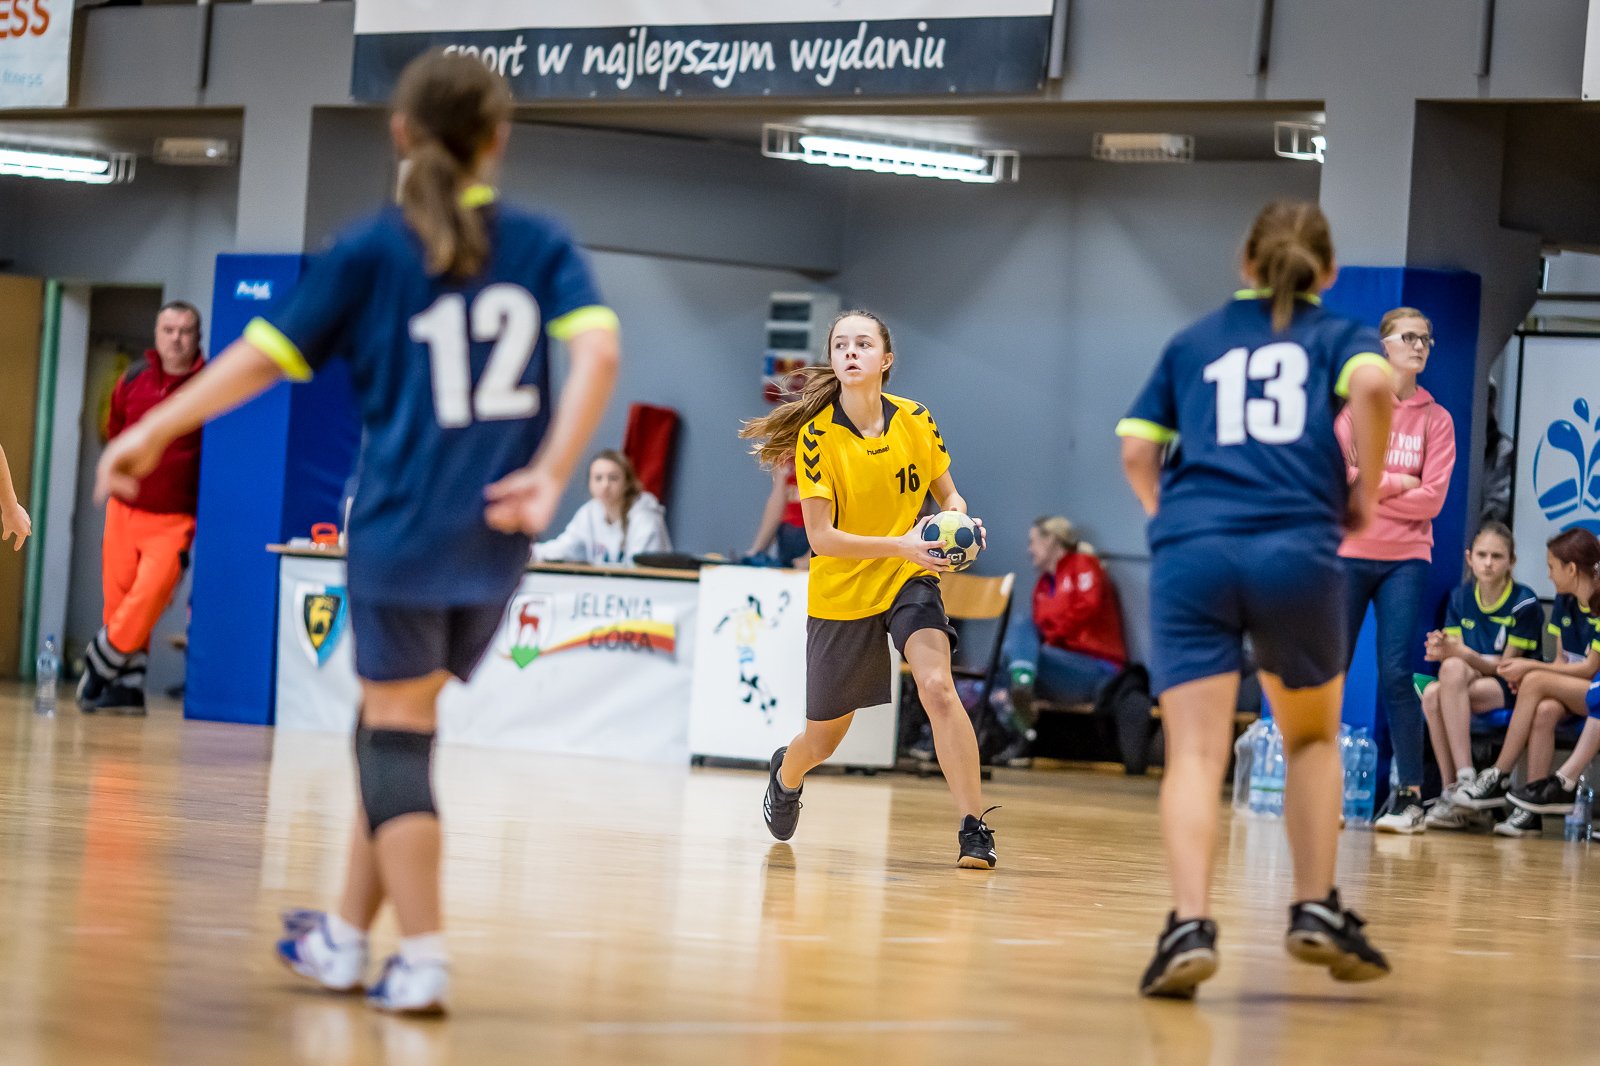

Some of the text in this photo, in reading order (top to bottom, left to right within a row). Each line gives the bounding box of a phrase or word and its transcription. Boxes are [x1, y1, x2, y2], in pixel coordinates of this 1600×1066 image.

[537, 43, 573, 76] w
[581, 26, 776, 92] najlepszym
[789, 21, 946, 87] wydaniu
[408, 282, 541, 429] 12
[1203, 341, 1310, 446] 13
[866, 444, 890, 456] hummel
[895, 463, 920, 494] 16
[571, 592, 653, 621] JELENIA
